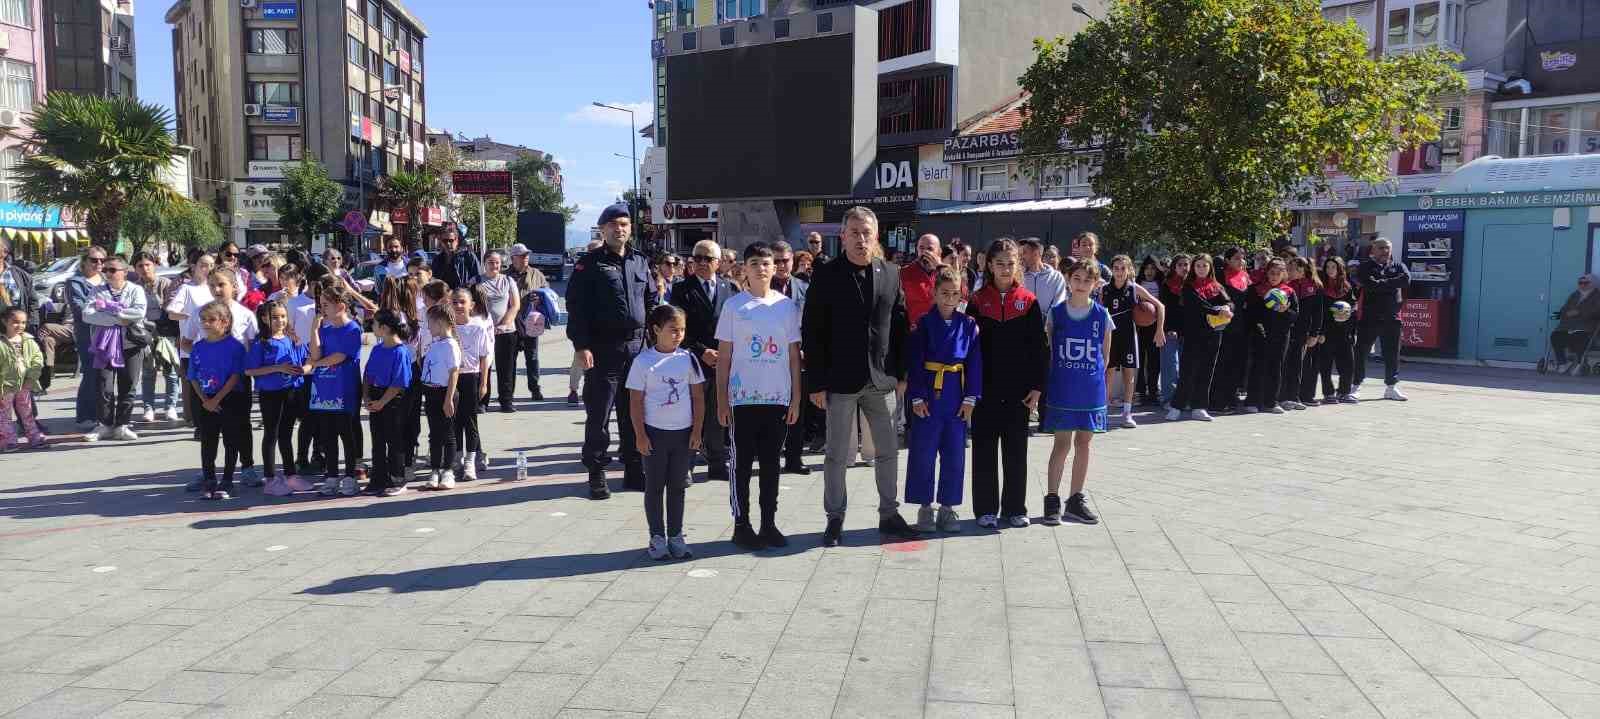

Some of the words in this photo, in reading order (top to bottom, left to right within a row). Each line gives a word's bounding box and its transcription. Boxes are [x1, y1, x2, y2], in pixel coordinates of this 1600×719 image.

[1436, 196, 1475, 207] BEBEK
[1479, 195, 1519, 207] BAKIM
[1522, 194, 1539, 204] VE
